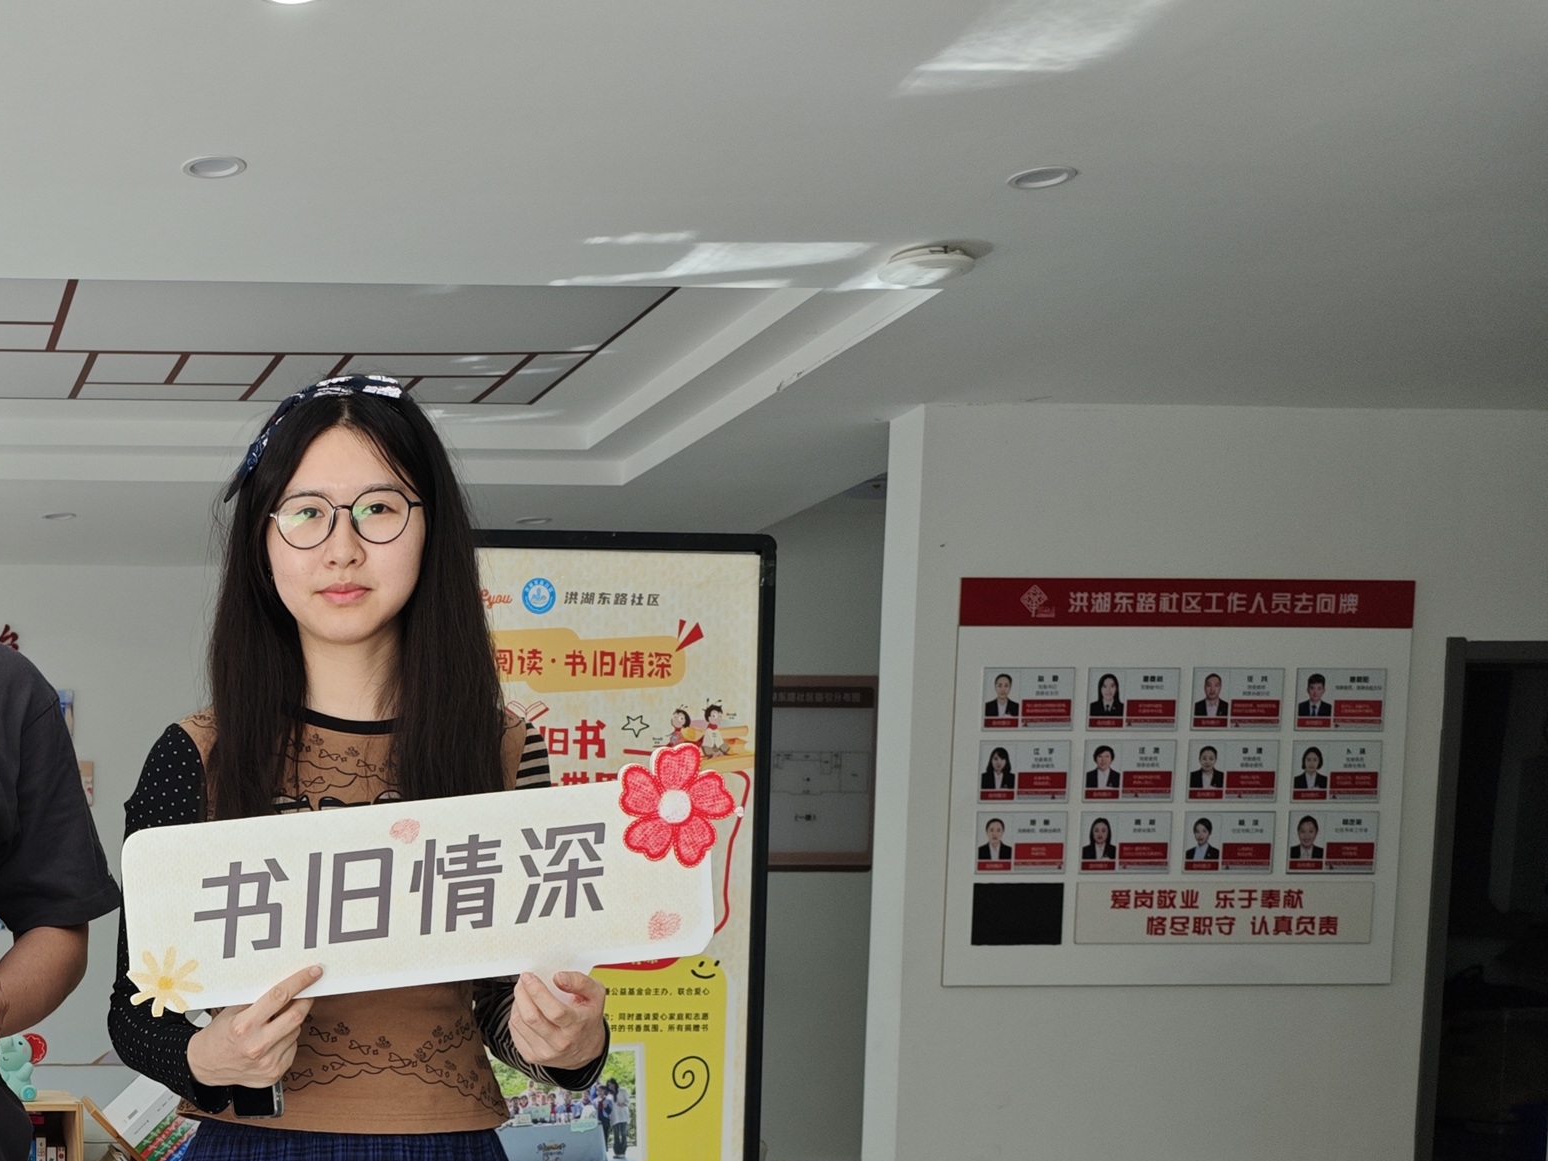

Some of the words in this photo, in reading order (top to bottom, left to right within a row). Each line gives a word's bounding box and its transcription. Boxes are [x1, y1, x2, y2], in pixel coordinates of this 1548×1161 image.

[563, 591, 661, 606] 洪湖东路社区
[1068, 591, 1360, 615] 洪湖东路社区工作人员去向牌
[193, 822, 607, 960] 书旧情深
[1110, 889, 1200, 910] 爱岗敬业
[1214, 888, 1304, 909] 乐于奉献
[1250, 915, 1339, 936] 认真负责
